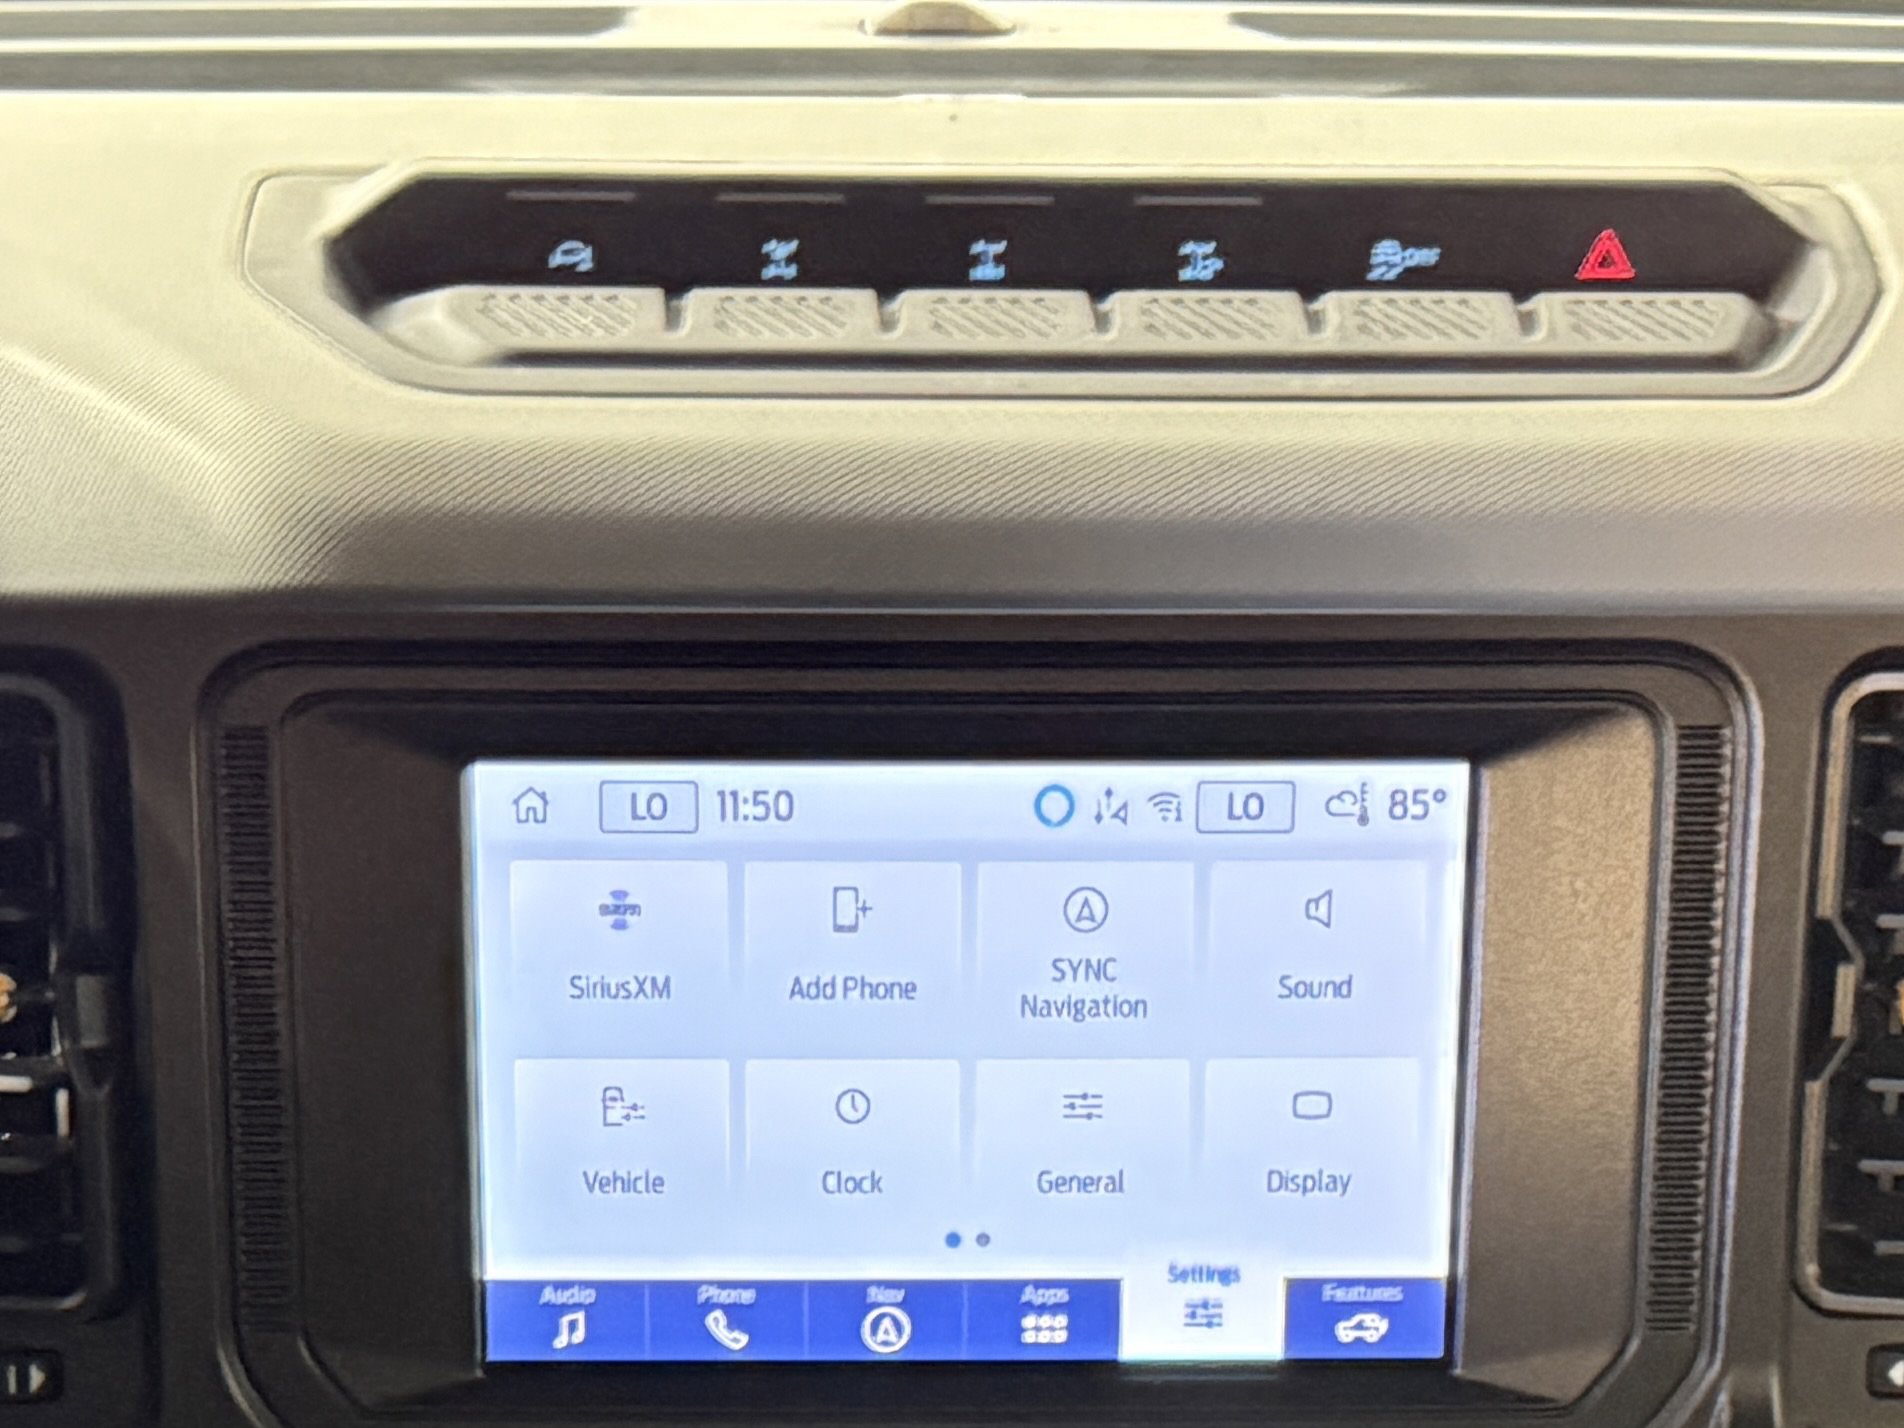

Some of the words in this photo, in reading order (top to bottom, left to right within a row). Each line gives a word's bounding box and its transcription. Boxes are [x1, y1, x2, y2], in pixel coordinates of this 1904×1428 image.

[629, 792, 669, 822] LO
[717, 789, 795, 823] 11:50
[1227, 792, 1265, 821] LO
[1050, 957, 1117, 983] SYNC
[569, 974, 671, 1000] SiriusXM
[789, 974, 837, 1000] Add
[842, 974, 918, 1001] Phone
[1277, 974, 1353, 1000] Sound
[1020, 994, 1148, 1022] Navigation
[582, 1169, 666, 1195] Vehicle
[821, 1170, 883, 1195] Clock
[1037, 1169, 1125, 1195] General
[1266, 1169, 1352, 1199] Display
[1168, 1260, 1242, 1288] Settings
[539, 1284, 597, 1306] Audio
[697, 1284, 757, 1307] Phone
[866, 1284, 906, 1306] Nav
[1020, 1283, 1070, 1308] Apps
